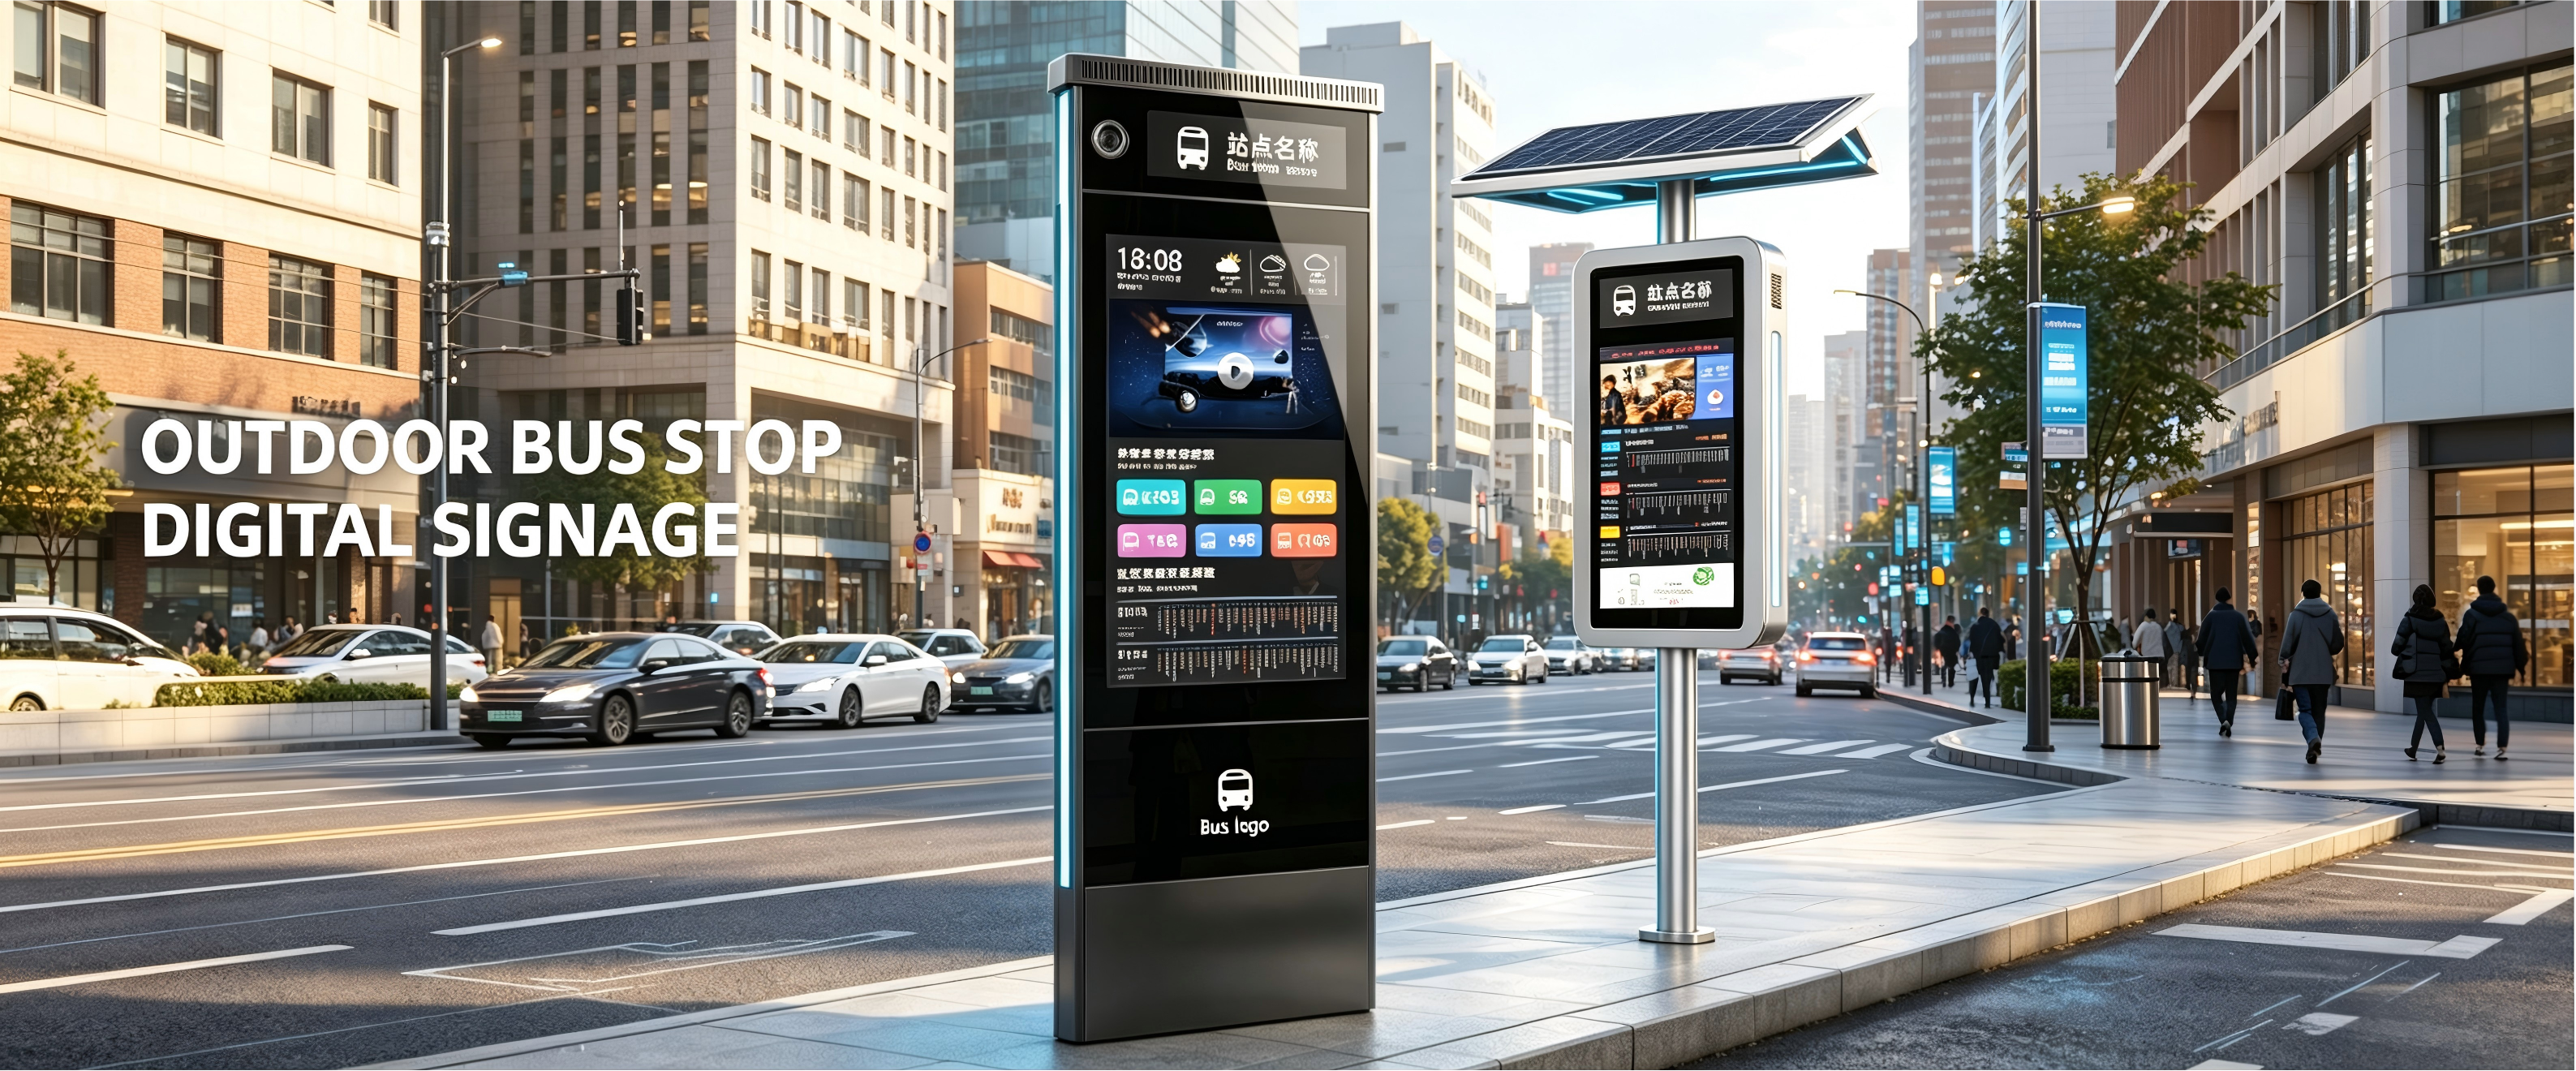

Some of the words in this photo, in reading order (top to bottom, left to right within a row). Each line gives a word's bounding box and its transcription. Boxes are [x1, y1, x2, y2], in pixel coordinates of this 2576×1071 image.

[1117, 247, 1183, 273] 18:08
[1200, 819, 1229, 836] Bus
[1235, 815, 1270, 837] logo
